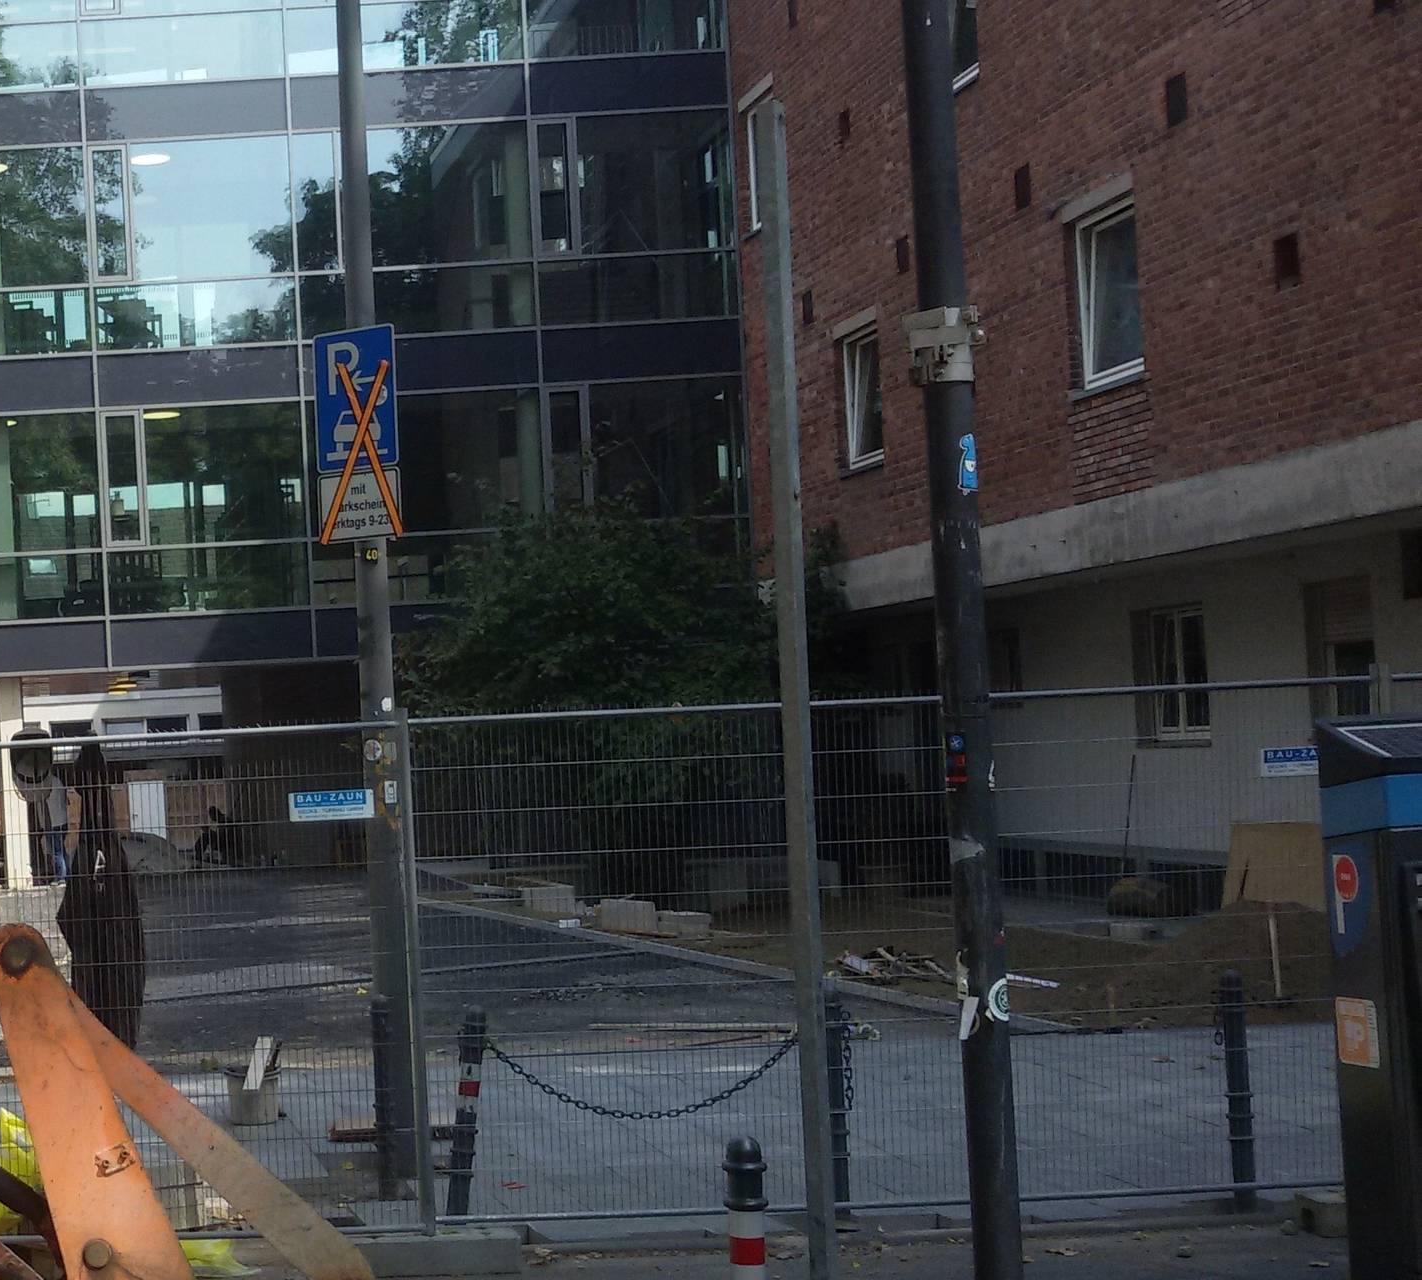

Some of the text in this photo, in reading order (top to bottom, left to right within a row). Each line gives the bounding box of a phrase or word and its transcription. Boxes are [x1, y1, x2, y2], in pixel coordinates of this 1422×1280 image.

[326, 341, 360, 396] P
[350, 483, 366, 496] mit
[336, 498, 387, 513] arkschein
[327, 517, 367, 531] erktags
[296, 791, 364, 804] BAU-ZAUN
